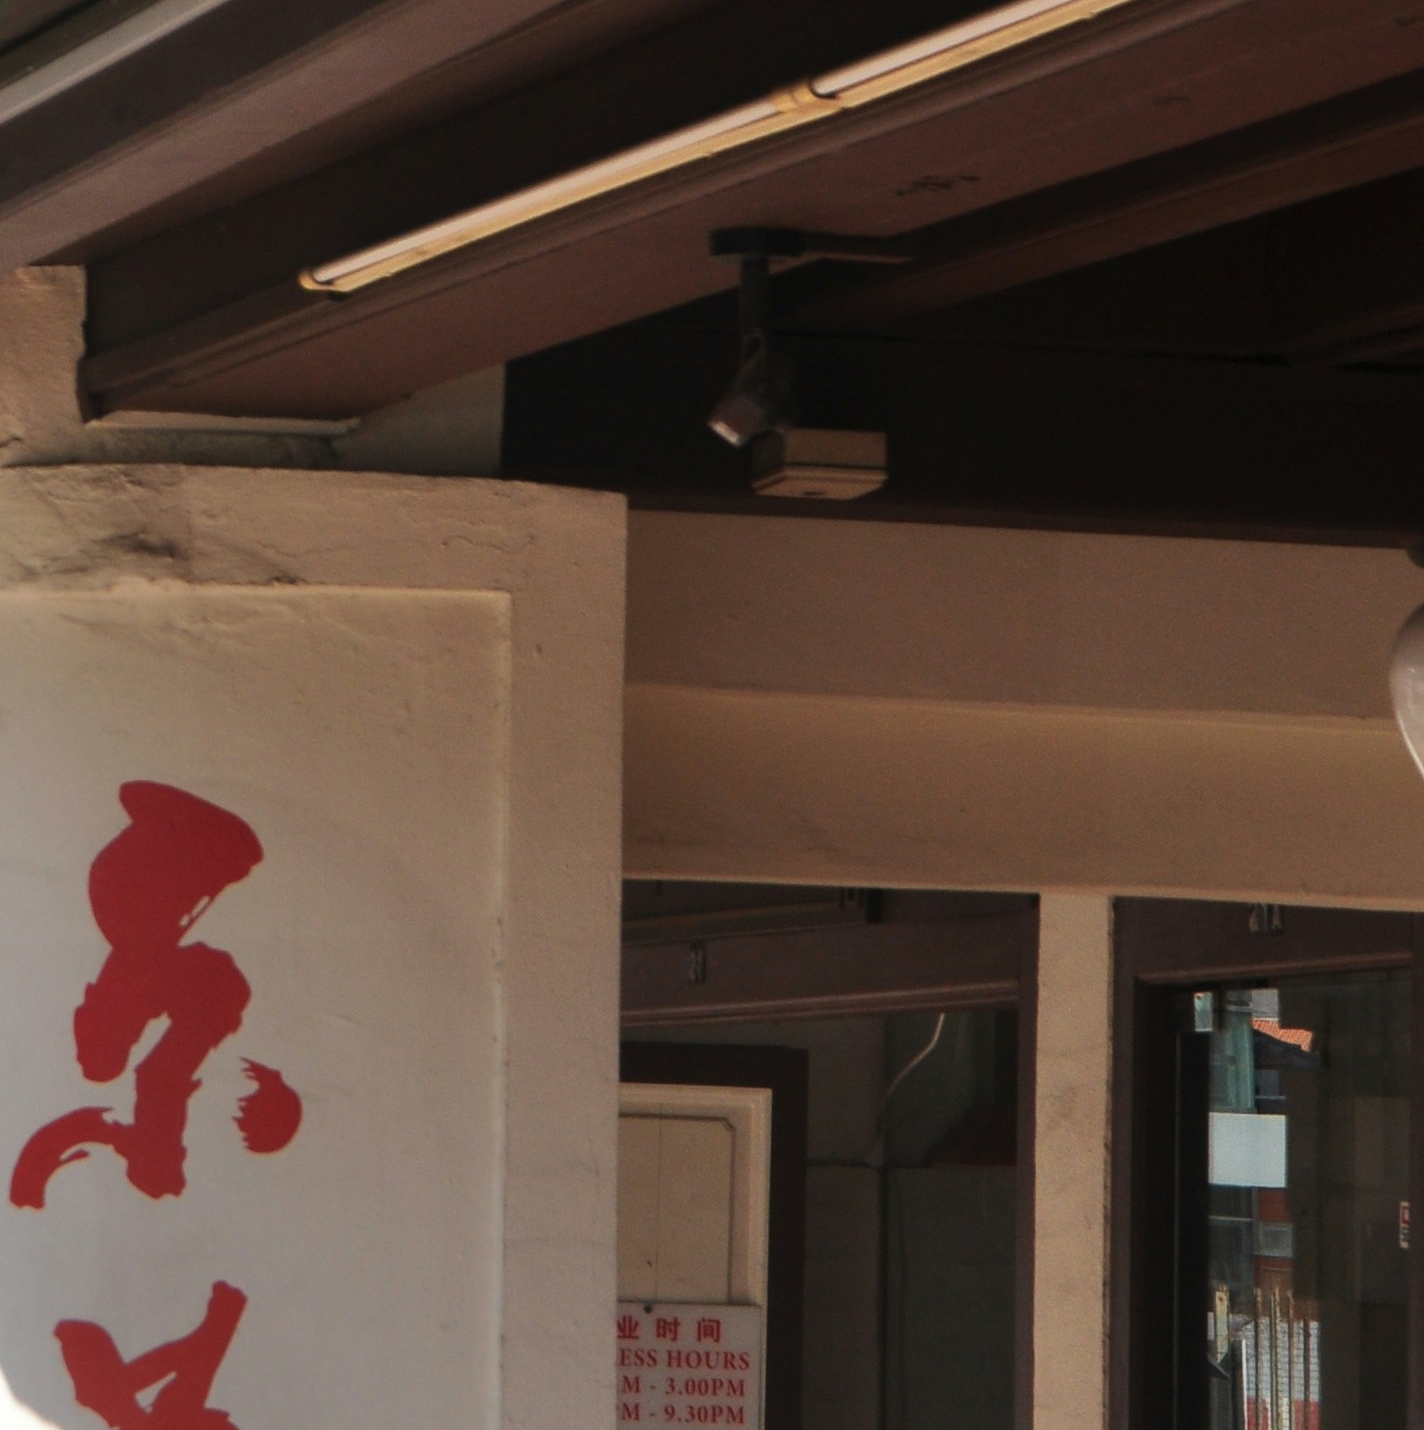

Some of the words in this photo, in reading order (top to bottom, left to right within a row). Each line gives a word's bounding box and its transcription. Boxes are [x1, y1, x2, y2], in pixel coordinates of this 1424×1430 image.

[667, 1350, 751, 1371] HOURS
[665, 1377, 746, 1398] 3.00PM
[664, 1404, 746, 1425] 9.30PM
